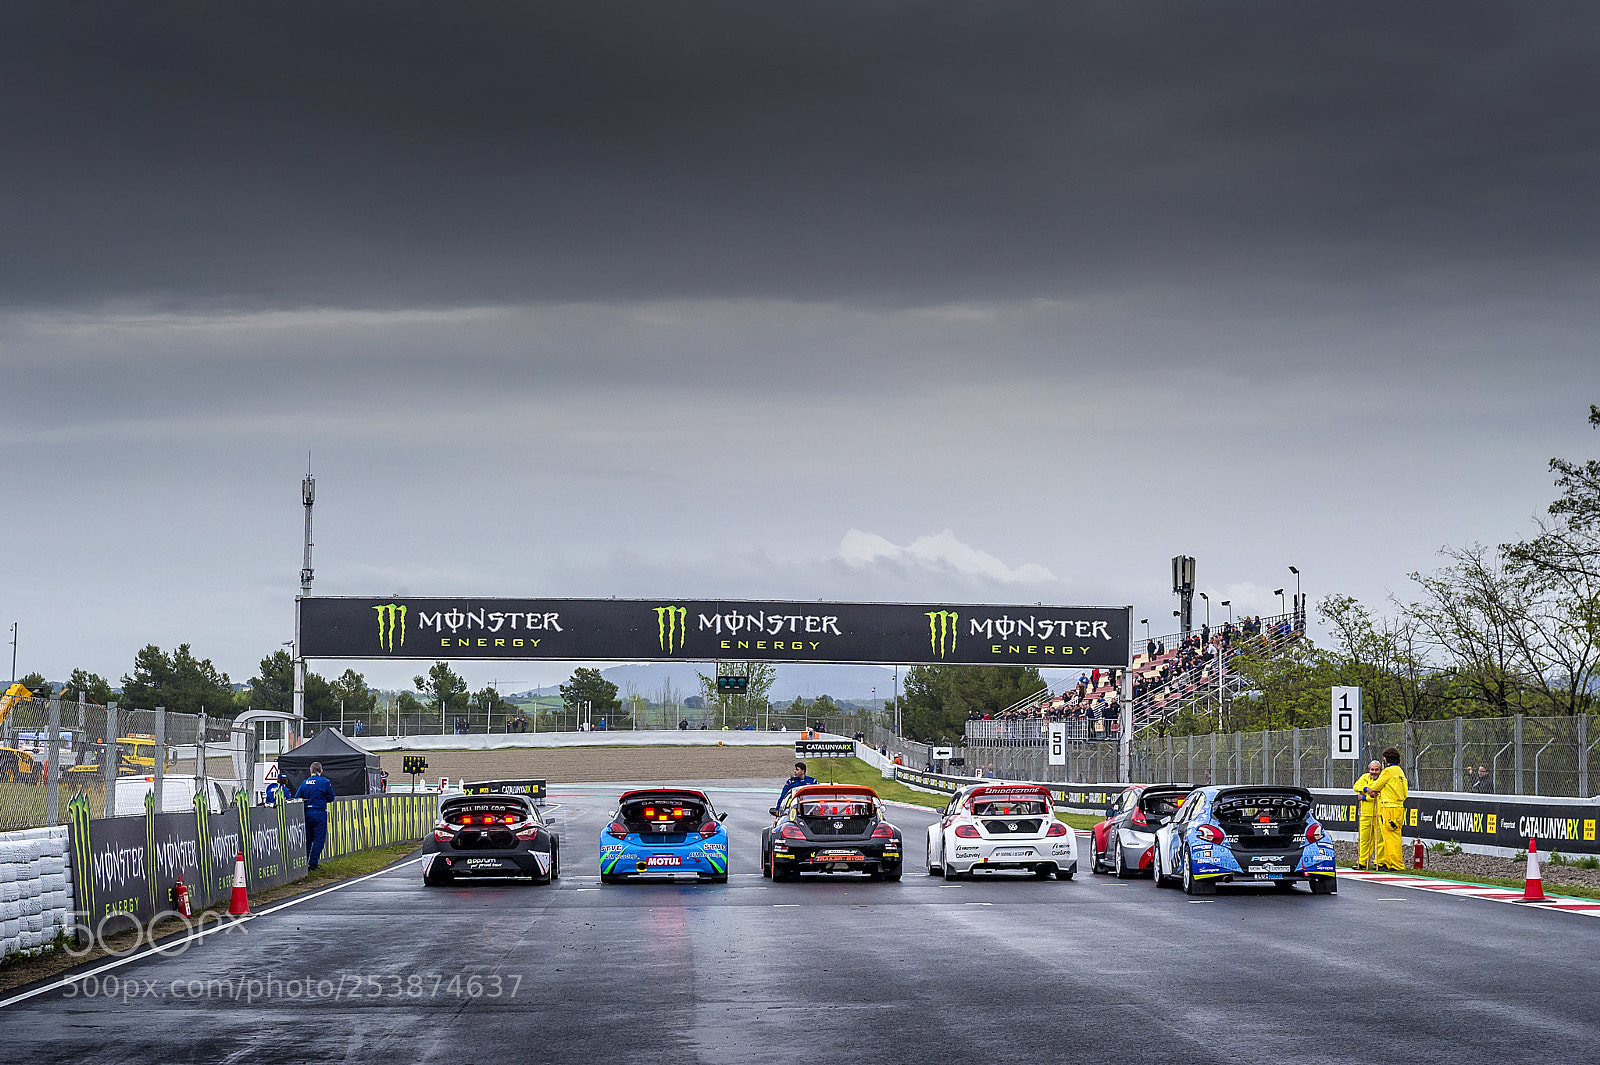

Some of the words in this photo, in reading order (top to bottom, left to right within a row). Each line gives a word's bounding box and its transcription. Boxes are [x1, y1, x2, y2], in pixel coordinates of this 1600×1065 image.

[419, 608, 563, 633] MONSTER
[699, 610, 841, 636] MONSTER
[970, 615, 1112, 642] MONSTER
[441, 638, 541, 648] ENERGY
[720, 640, 820, 650] ENERGY
[991, 645, 1091, 655] ENERGY
[1338, 692, 1353, 753] 100
[806, 742, 852, 750] CATALUNYARX
[1052, 732, 1062, 755] 50
[440, 778, 448, 789] F
[1219, 797, 1309, 811] PEUGEOT
[1315, 803, 1348, 822] CATALUNYARX
[1435, 809, 1484, 833] CATALUNYARX
[1519, 815, 1580, 841] CATALUNYARX
[156, 834, 199, 878] MONSTER
[292, 855, 307, 870] ENERG
[647, 857, 681, 866] MOTUL
[94, 841, 146, 892] MONSTER
[258, 863, 280, 880] ENERGY
[218, 873, 234, 891] ENERG
[105, 896, 140, 919] ENERGY
